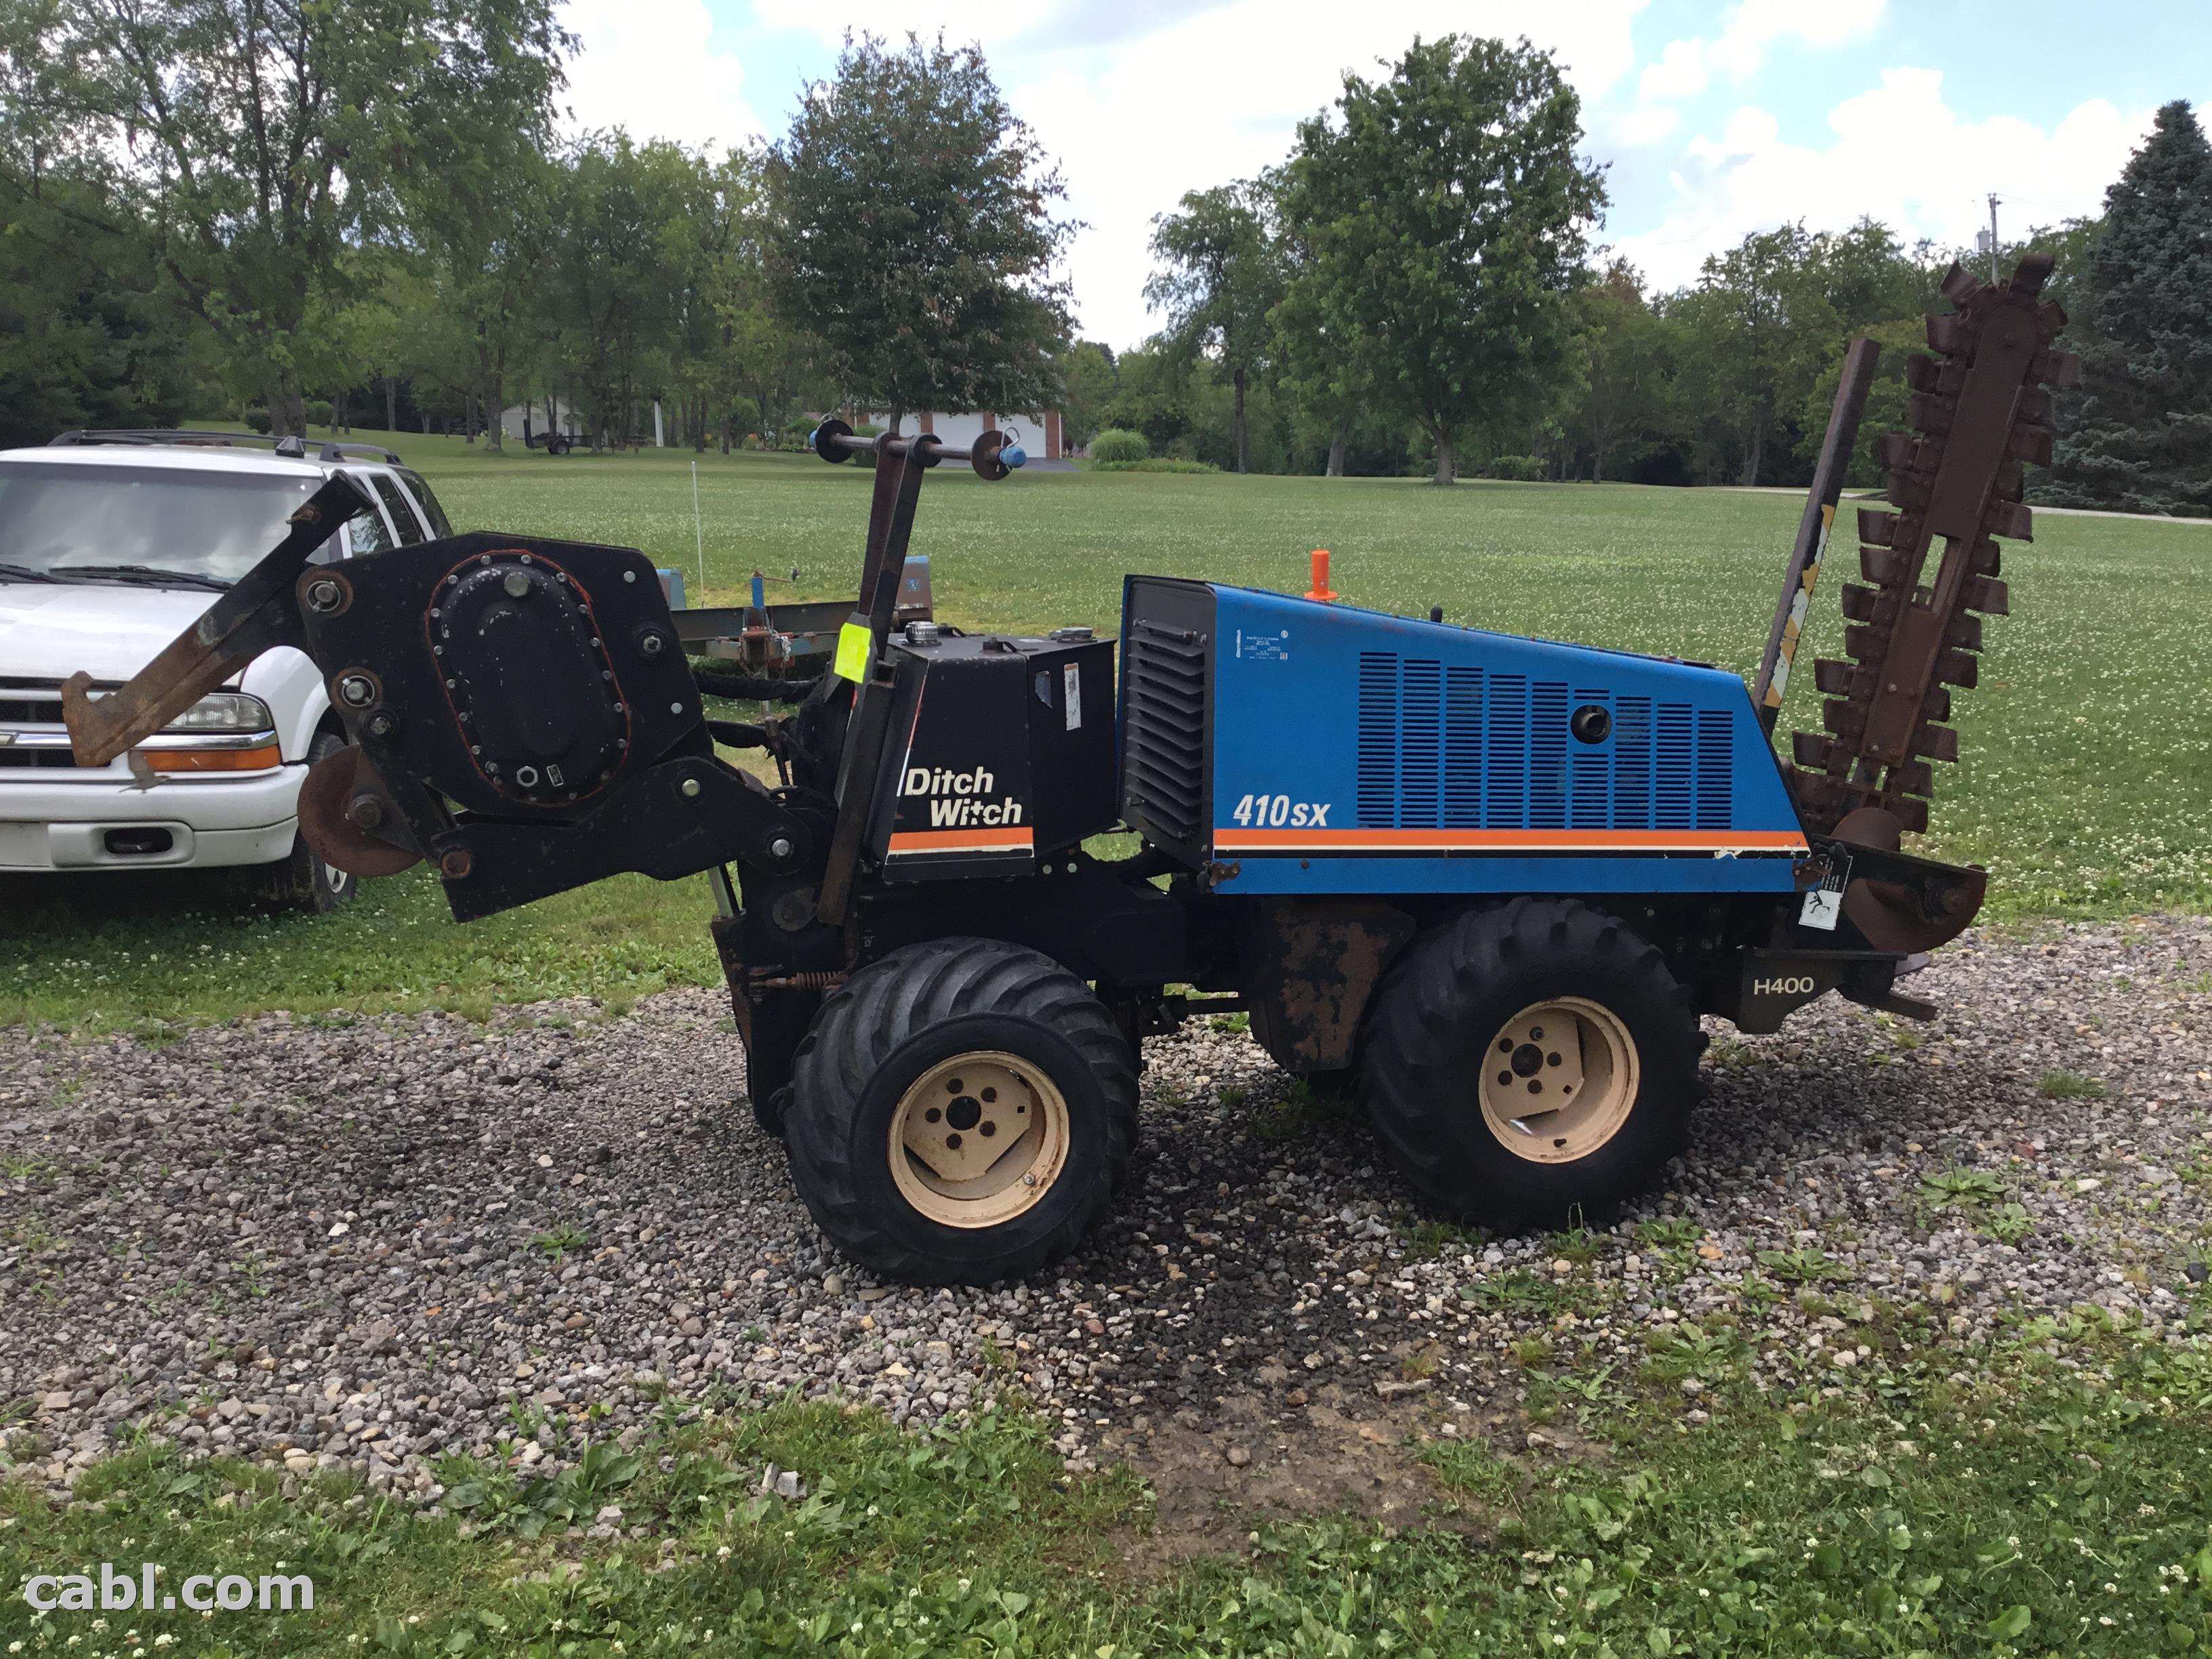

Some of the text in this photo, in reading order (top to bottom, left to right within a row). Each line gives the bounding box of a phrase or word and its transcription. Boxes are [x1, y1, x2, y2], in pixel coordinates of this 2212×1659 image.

[905, 766, 994, 796] Ditch
[930, 797, 1022, 827] Witch
[1754, 977, 1814, 995] H400
